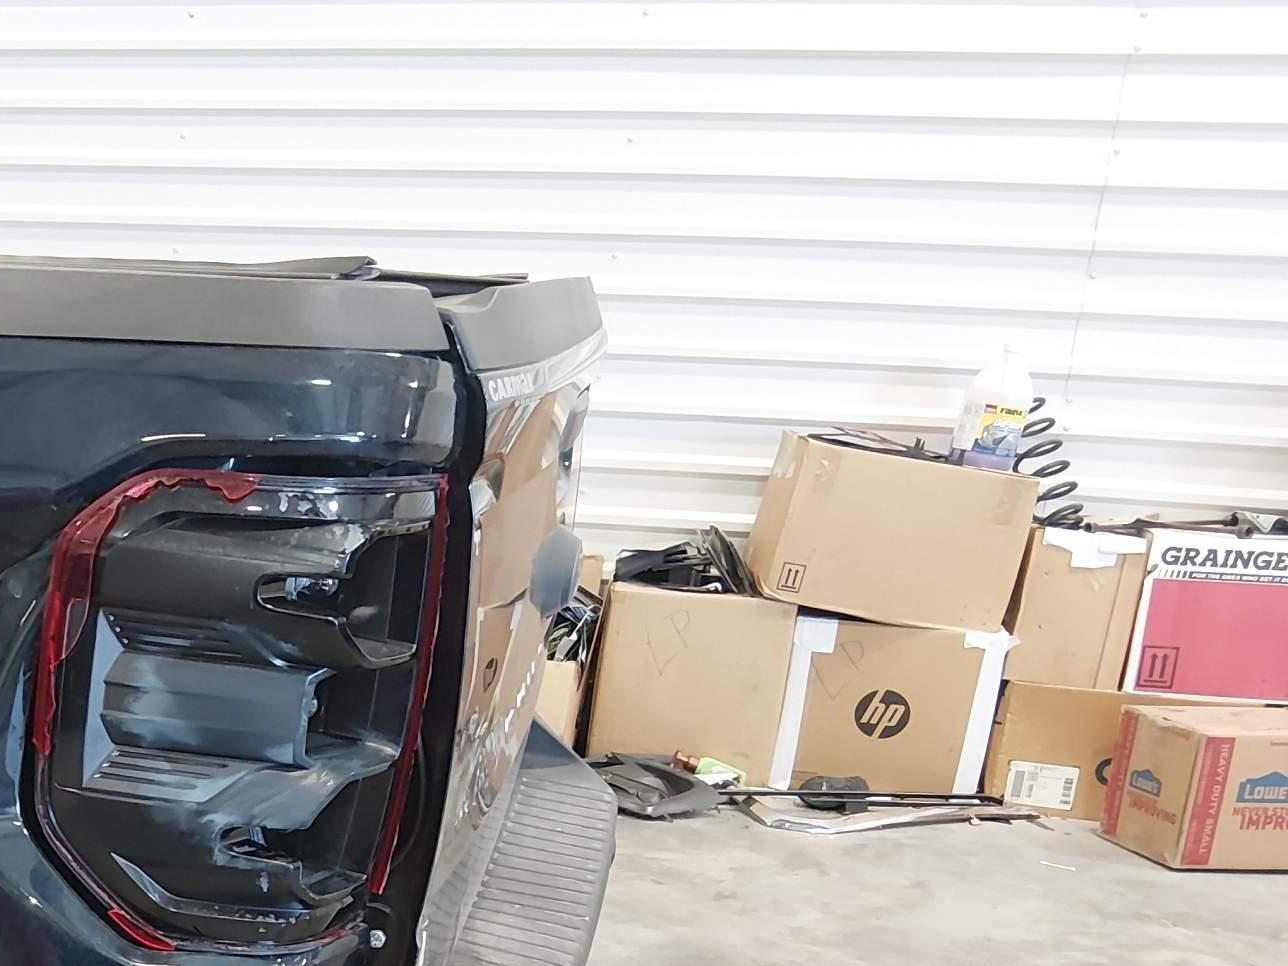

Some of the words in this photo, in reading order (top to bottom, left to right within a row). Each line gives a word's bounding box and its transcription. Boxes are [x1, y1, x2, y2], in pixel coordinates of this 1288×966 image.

[858, 688, 907, 739] hp
[1215, 743, 1231, 782] HEAVY
[1208, 784, 1222, 815] DUTY
[1240, 814, 1288, 830] IMPR
